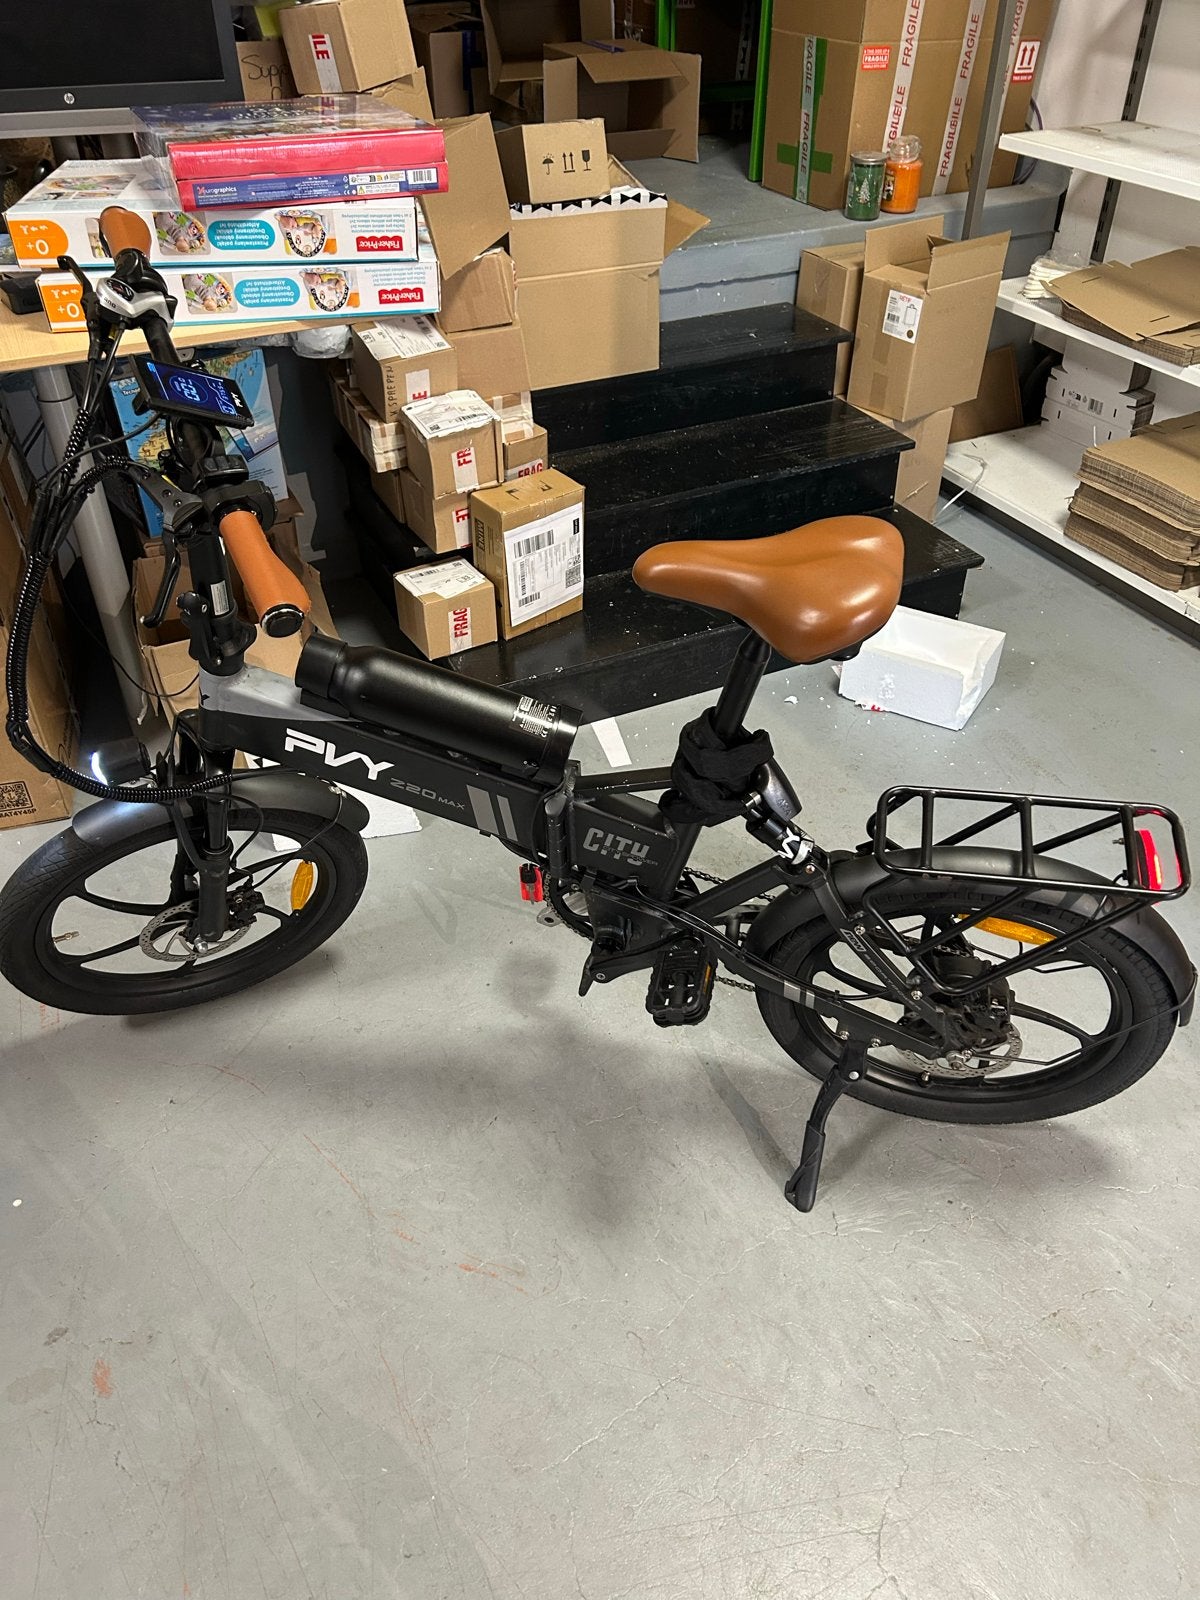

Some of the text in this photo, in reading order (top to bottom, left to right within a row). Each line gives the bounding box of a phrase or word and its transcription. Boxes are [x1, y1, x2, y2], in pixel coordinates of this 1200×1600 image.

[311, 33, 330, 60] ILE
[902, 0, 921, 67] FRAGILE
[959, 13, 980, 79] FRAGILE
[801, 111, 810, 175] FRAGILE
[412, 390, 428, 400] E
[456, 447, 472, 467] FR
[284, 727, 466, 811] PVY Z20 MAX
[582, 827, 650, 866] CITY
